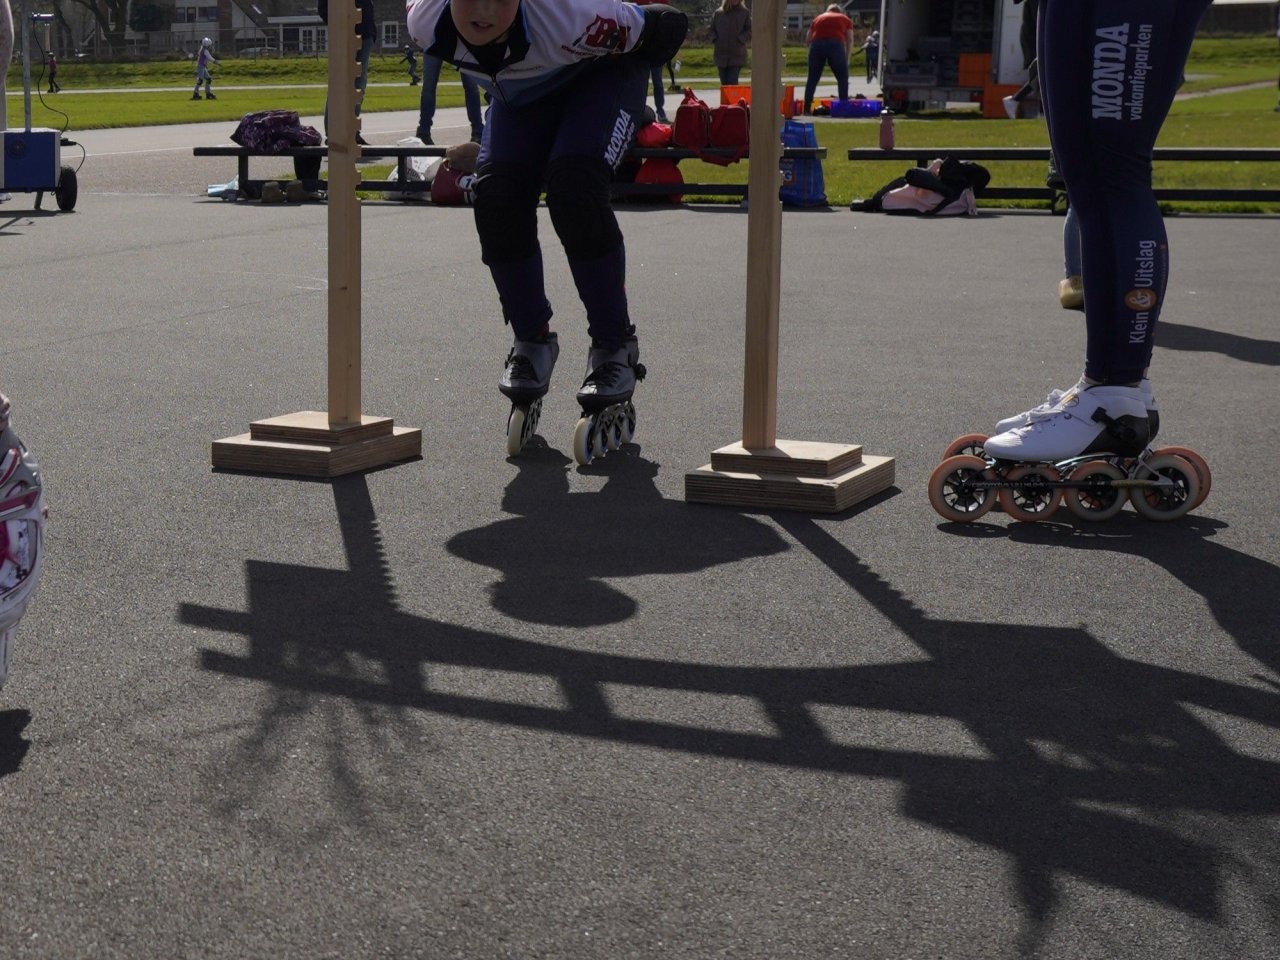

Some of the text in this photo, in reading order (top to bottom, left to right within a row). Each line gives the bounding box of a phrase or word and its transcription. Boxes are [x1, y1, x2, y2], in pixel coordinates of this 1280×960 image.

[1091, 22, 1130, 121] MONDA
[1124, 24, 1153, 121] vakantieparken
[604, 109, 631, 165] MONDA
[1134, 240, 1157, 288] Uitslag
[1129, 311, 1149, 344] Klein
